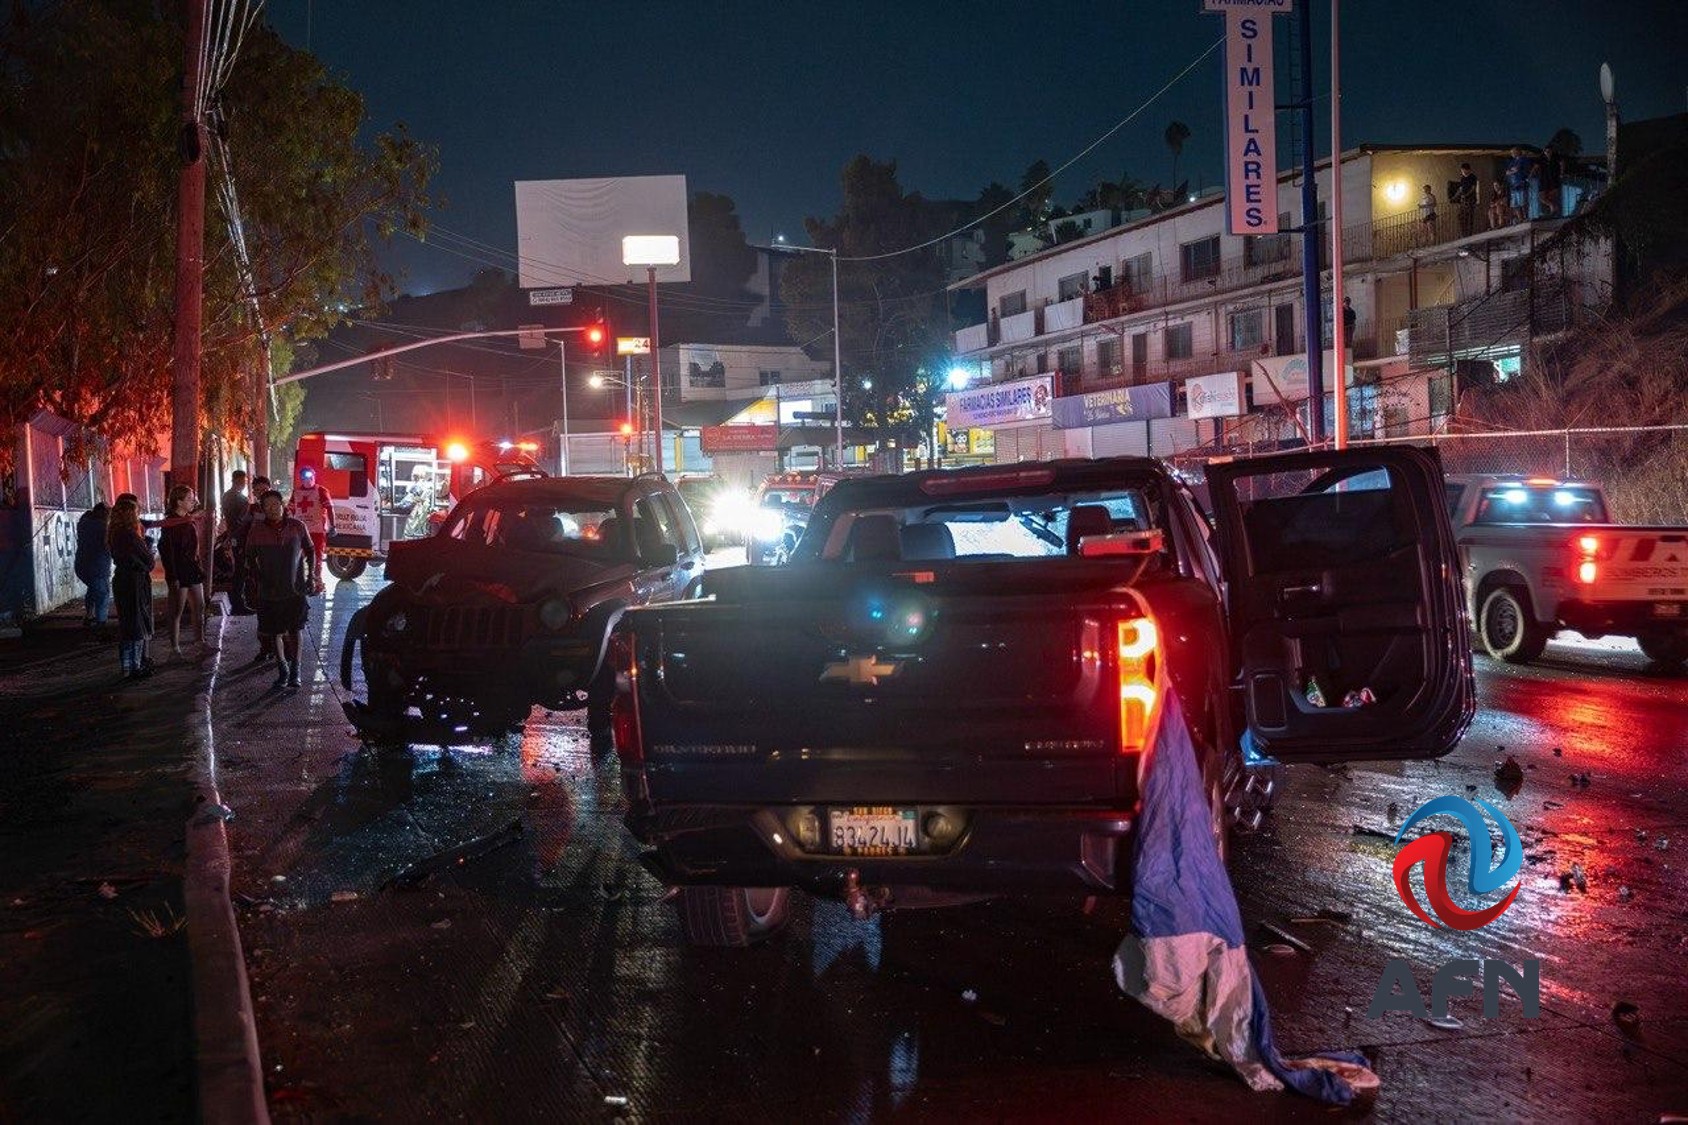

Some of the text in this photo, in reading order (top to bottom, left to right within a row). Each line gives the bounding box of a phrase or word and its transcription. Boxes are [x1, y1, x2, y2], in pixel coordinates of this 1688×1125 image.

[1240, 19, 1263, 228] SIMILARES
[960, 386, 1031, 413] FARMACIAS SIMILARES
